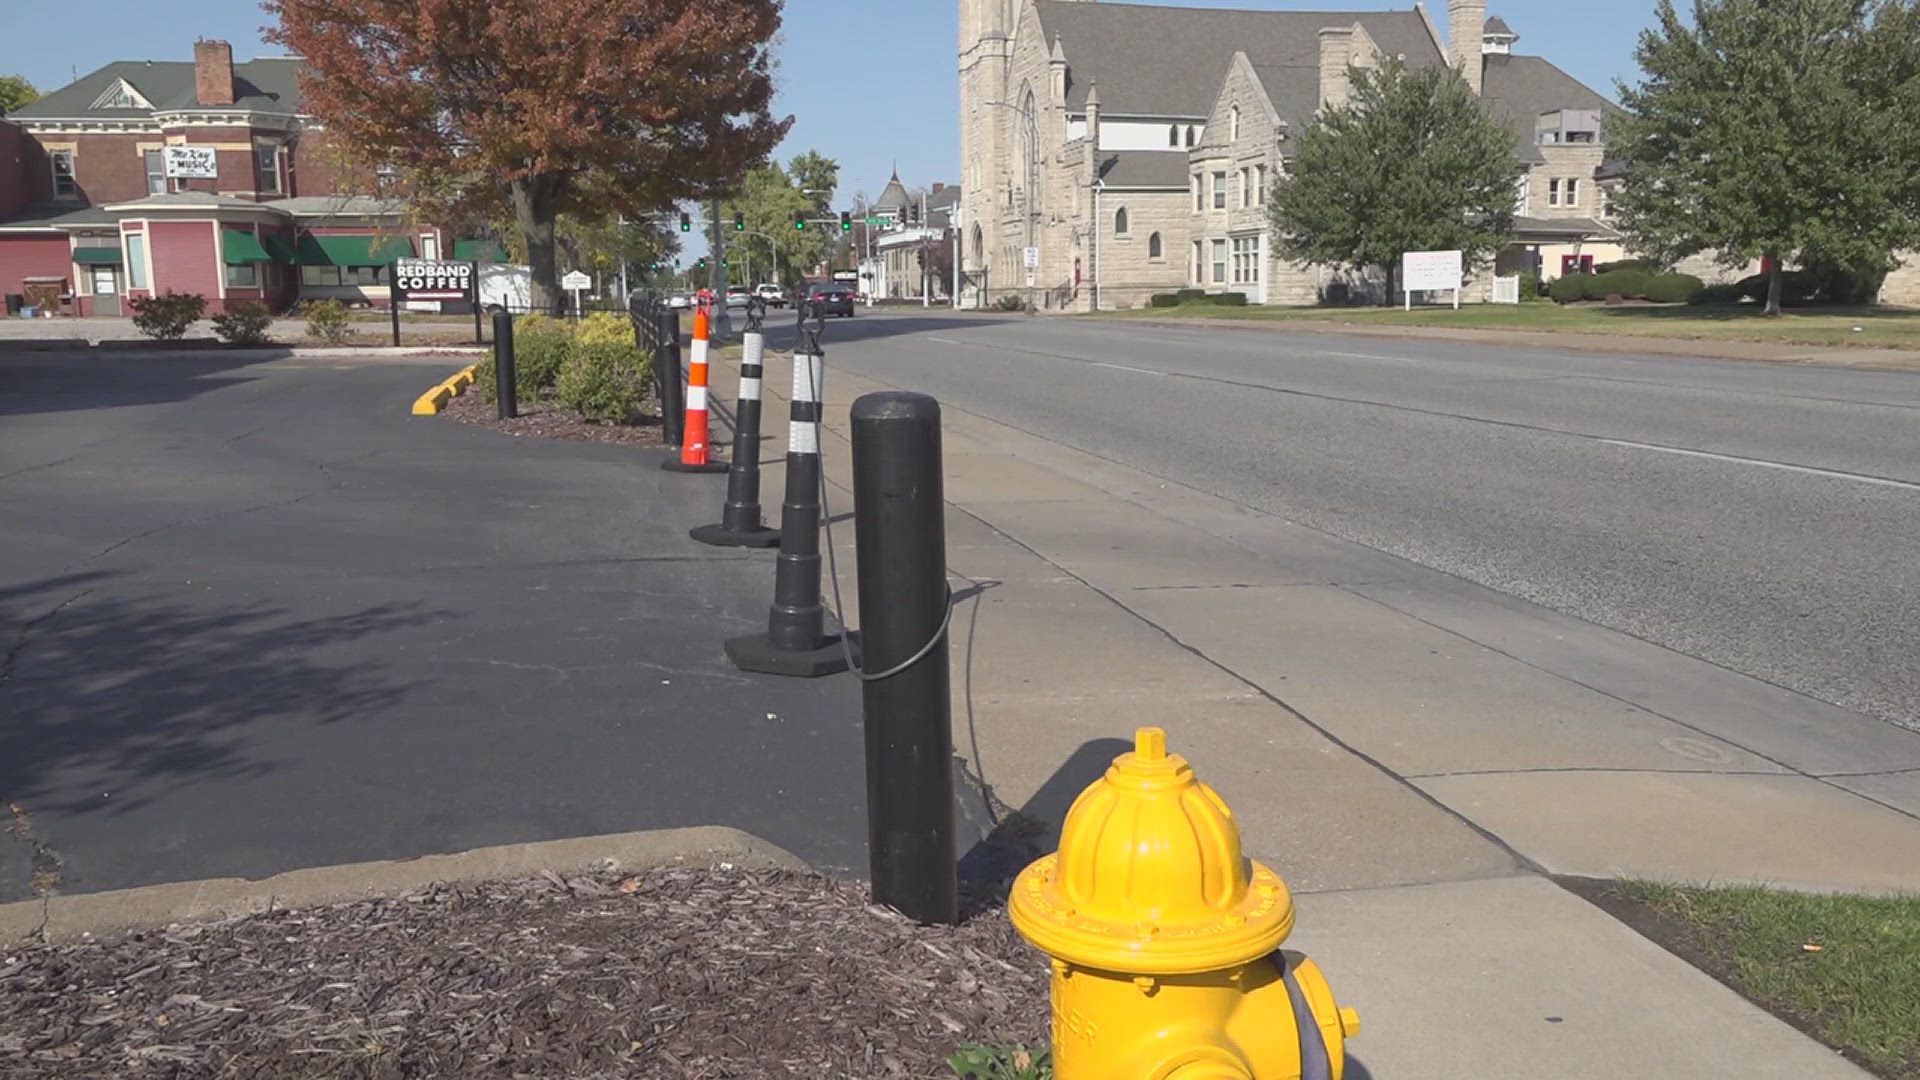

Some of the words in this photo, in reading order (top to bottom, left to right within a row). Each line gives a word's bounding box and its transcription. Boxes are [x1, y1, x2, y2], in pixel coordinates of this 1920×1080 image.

[177, 159, 208, 169] MUSIC
[397, 265, 470, 277] REDBAND
[397, 277, 469, 290] COFFEE
